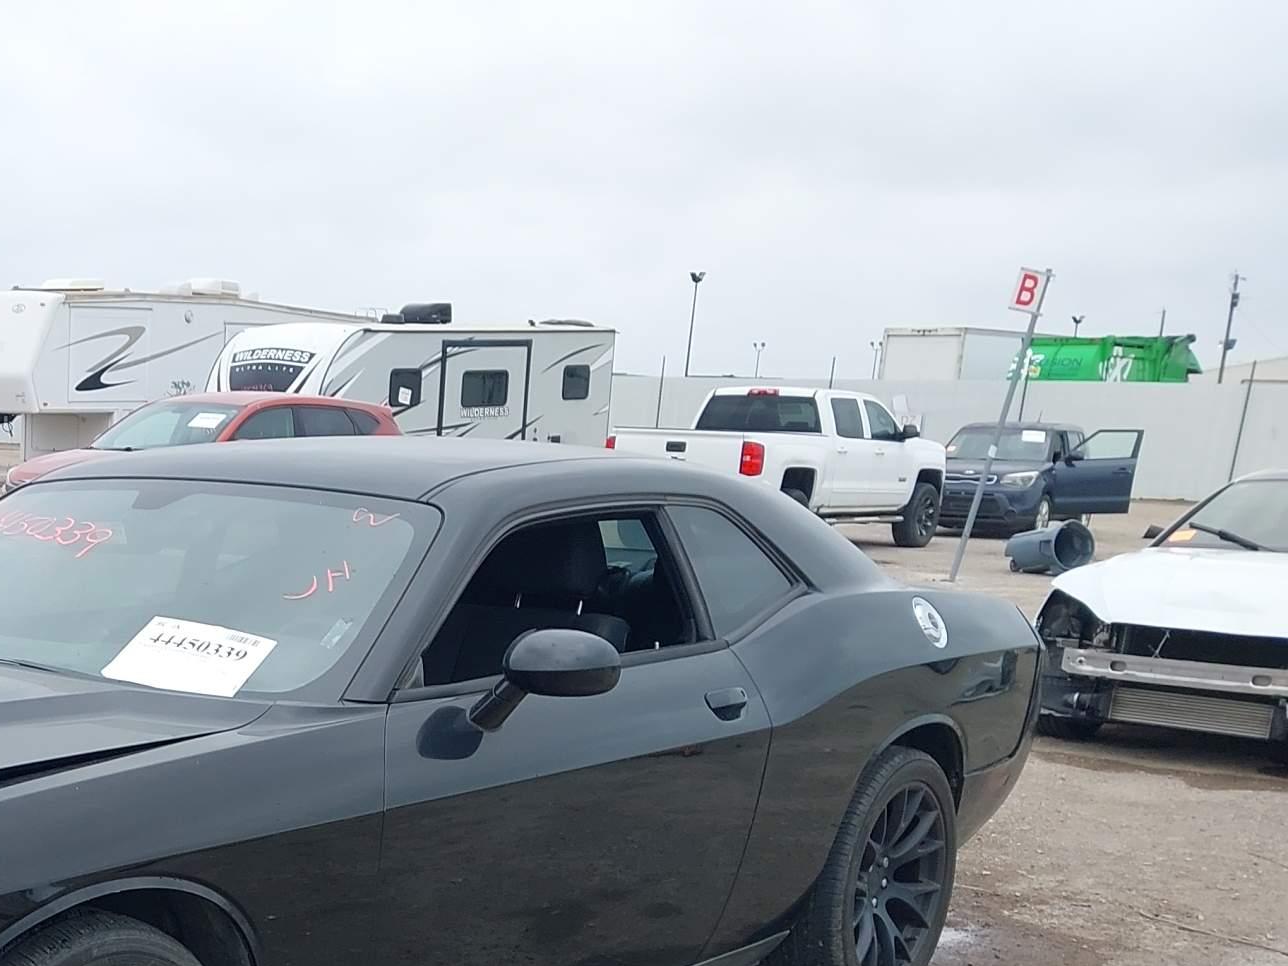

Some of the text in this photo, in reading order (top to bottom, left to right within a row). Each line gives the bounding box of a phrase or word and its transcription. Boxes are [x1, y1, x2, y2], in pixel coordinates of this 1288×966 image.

[1015, 273, 1039, 306] B
[234, 348, 311, 363] WILDERNESS
[460, 407, 510, 417] WILDERNESS
[149, 632, 248, 661] 44450339
